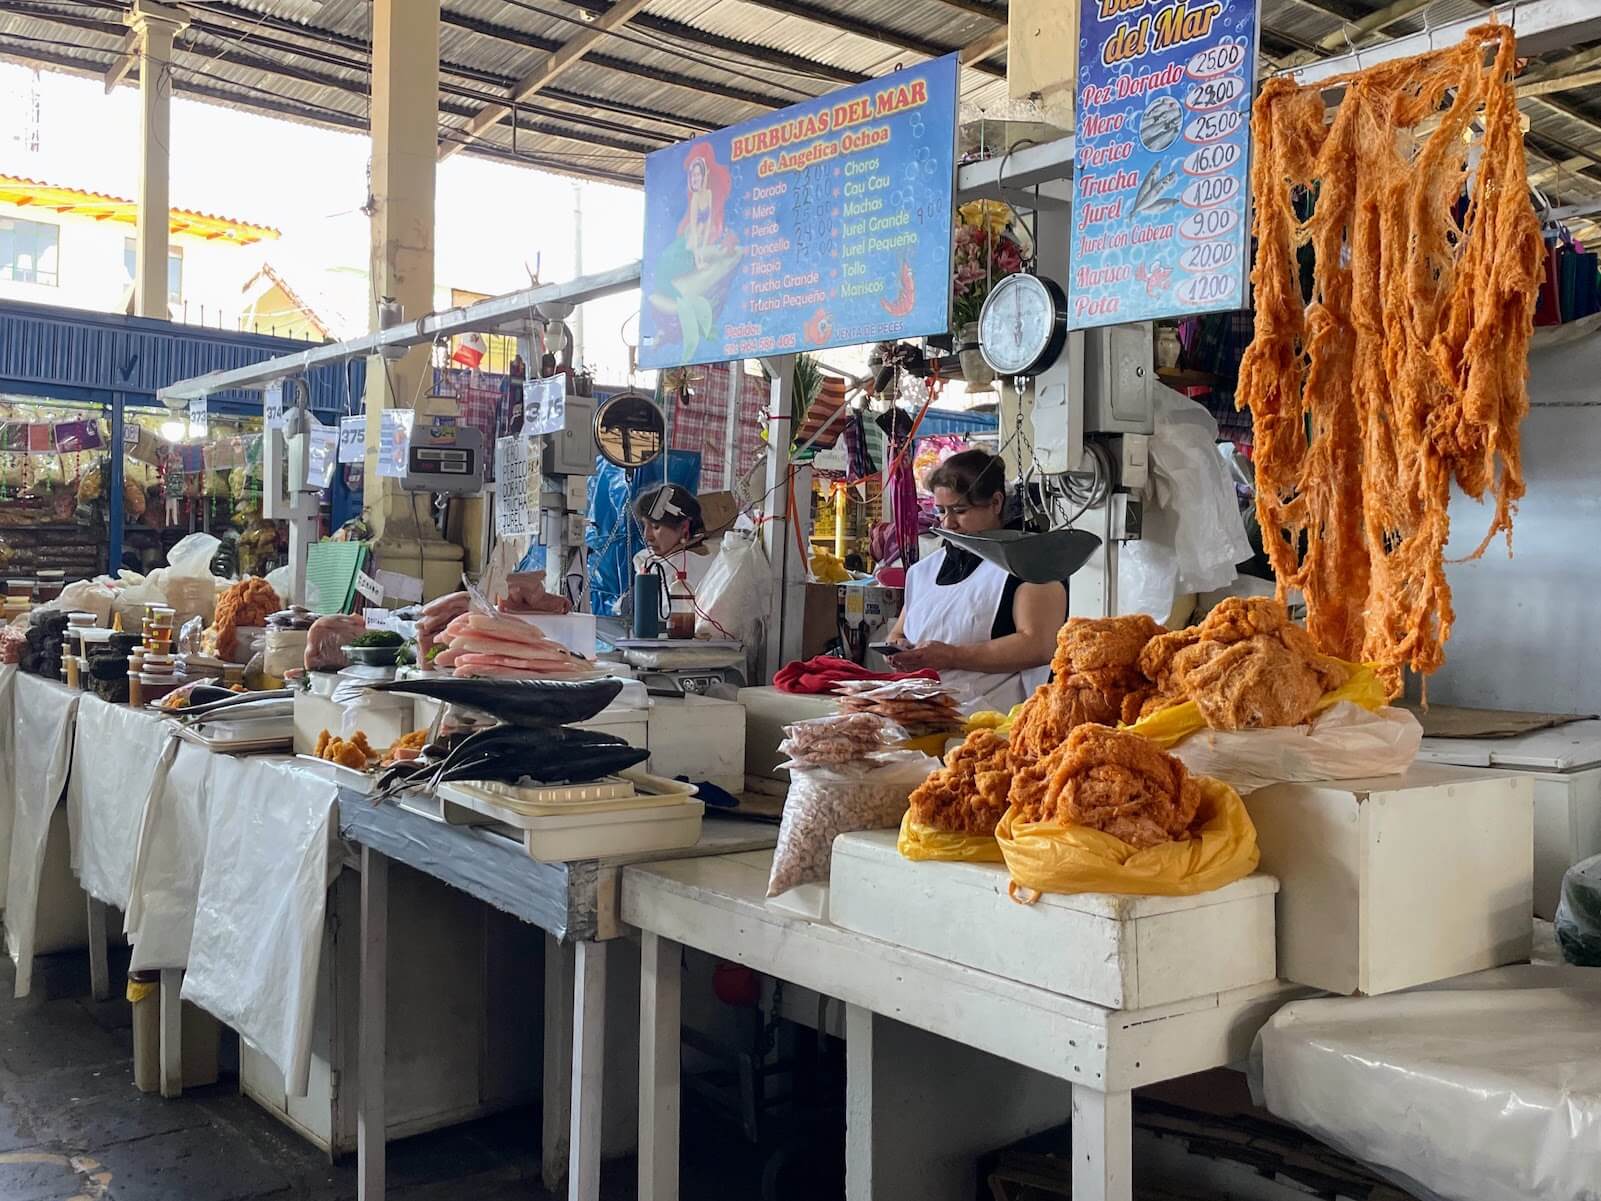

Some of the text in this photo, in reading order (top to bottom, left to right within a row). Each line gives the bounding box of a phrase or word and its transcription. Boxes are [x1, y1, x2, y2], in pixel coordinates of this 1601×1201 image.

[1103, 3, 1221, 65] del Mar
[1083, 84, 1110, 107] Pez
[1117, 63, 1185, 98] Dorado
[731, 81, 927, 159] BURBUJAS DEL MAR
[1082, 112, 1124, 138] Mero
[1081, 112, 1237, 167] Perico 25.00
[759, 159, 774, 176] de
[841, 127, 889, 151] Ochoa
[844, 158, 880, 176] Choros
[1080, 145, 1234, 197] Trucha 16.00
[752, 183, 787, 200] Dorado
[844, 176, 890, 197] Cau Cau
[752, 205, 775, 219] Mero
[843, 198, 883, 217] Machas
[1078, 198, 1122, 230] Jurel
[751, 223, 779, 238] Perico
[842, 219, 866, 238] Jurel
[868, 210, 910, 231] Grande
[1077, 210, 1229, 258] Jurel con Cabeza 9.00
[751, 239, 790, 256] Doncella
[842, 232, 917, 259] Jurel Pequeño
[751, 261, 781, 276] Tilapia
[843, 262, 866, 277] Tollo
[1077, 243, 1232, 288] Marisco 20.00
[751, 272, 819, 294] Trucha Grande
[841, 280, 884, 297] Mariscos
[751, 289, 826, 312] Trucha Pequeño
[1075, 295, 1119, 318] Pota
[191, 410, 206, 422] 373
[267, 406, 282, 420] 374
[341, 429, 365, 445] 375
